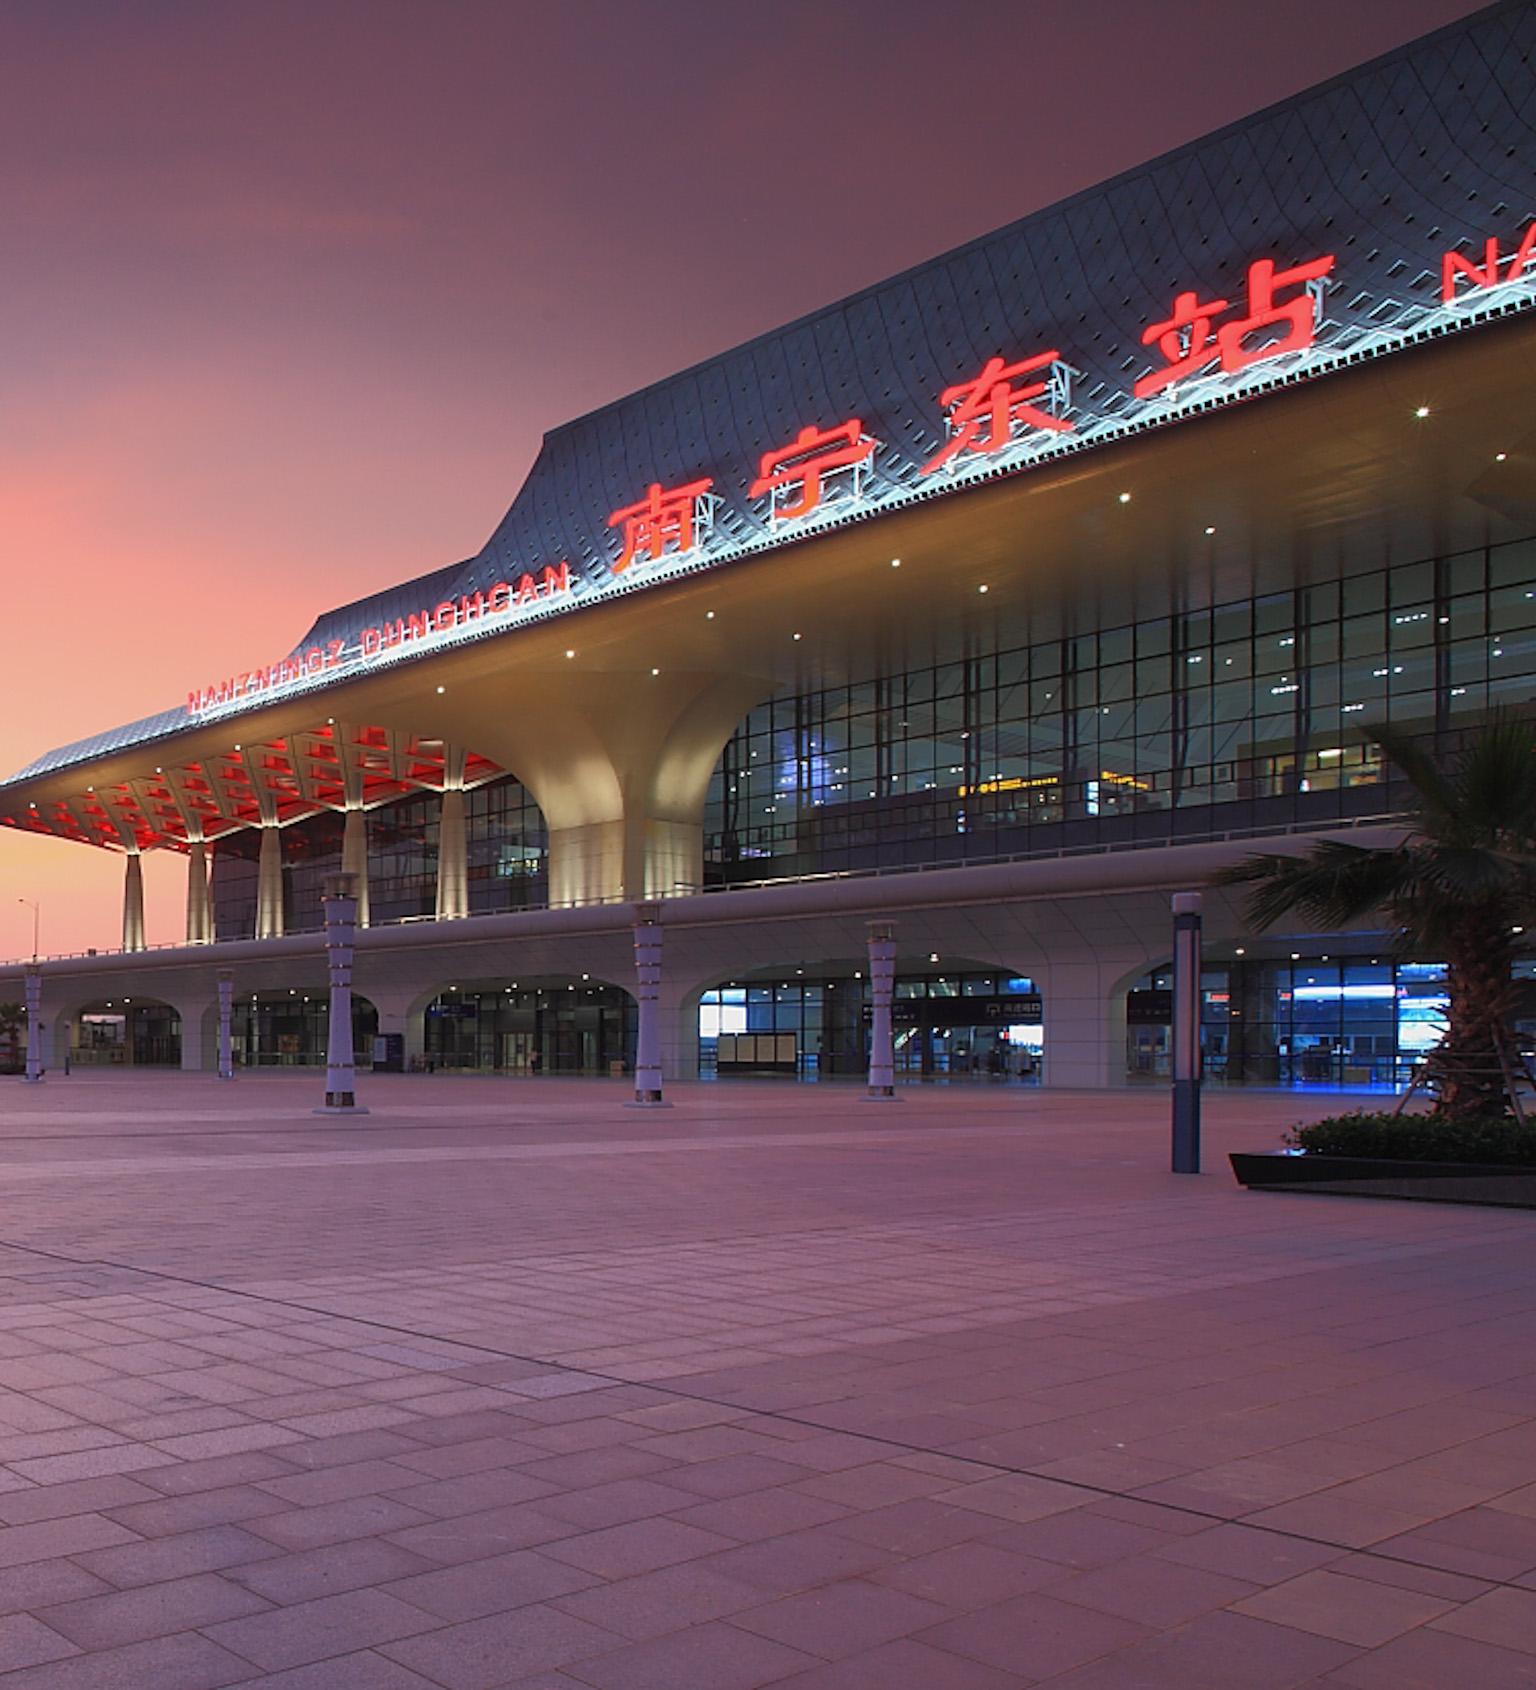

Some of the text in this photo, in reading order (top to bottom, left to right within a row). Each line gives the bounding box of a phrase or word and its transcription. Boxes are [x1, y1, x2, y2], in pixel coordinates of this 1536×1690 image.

[609, 254, 1335, 574] 南宁东站
[361, 561, 570, 656] DUNGHCAN
